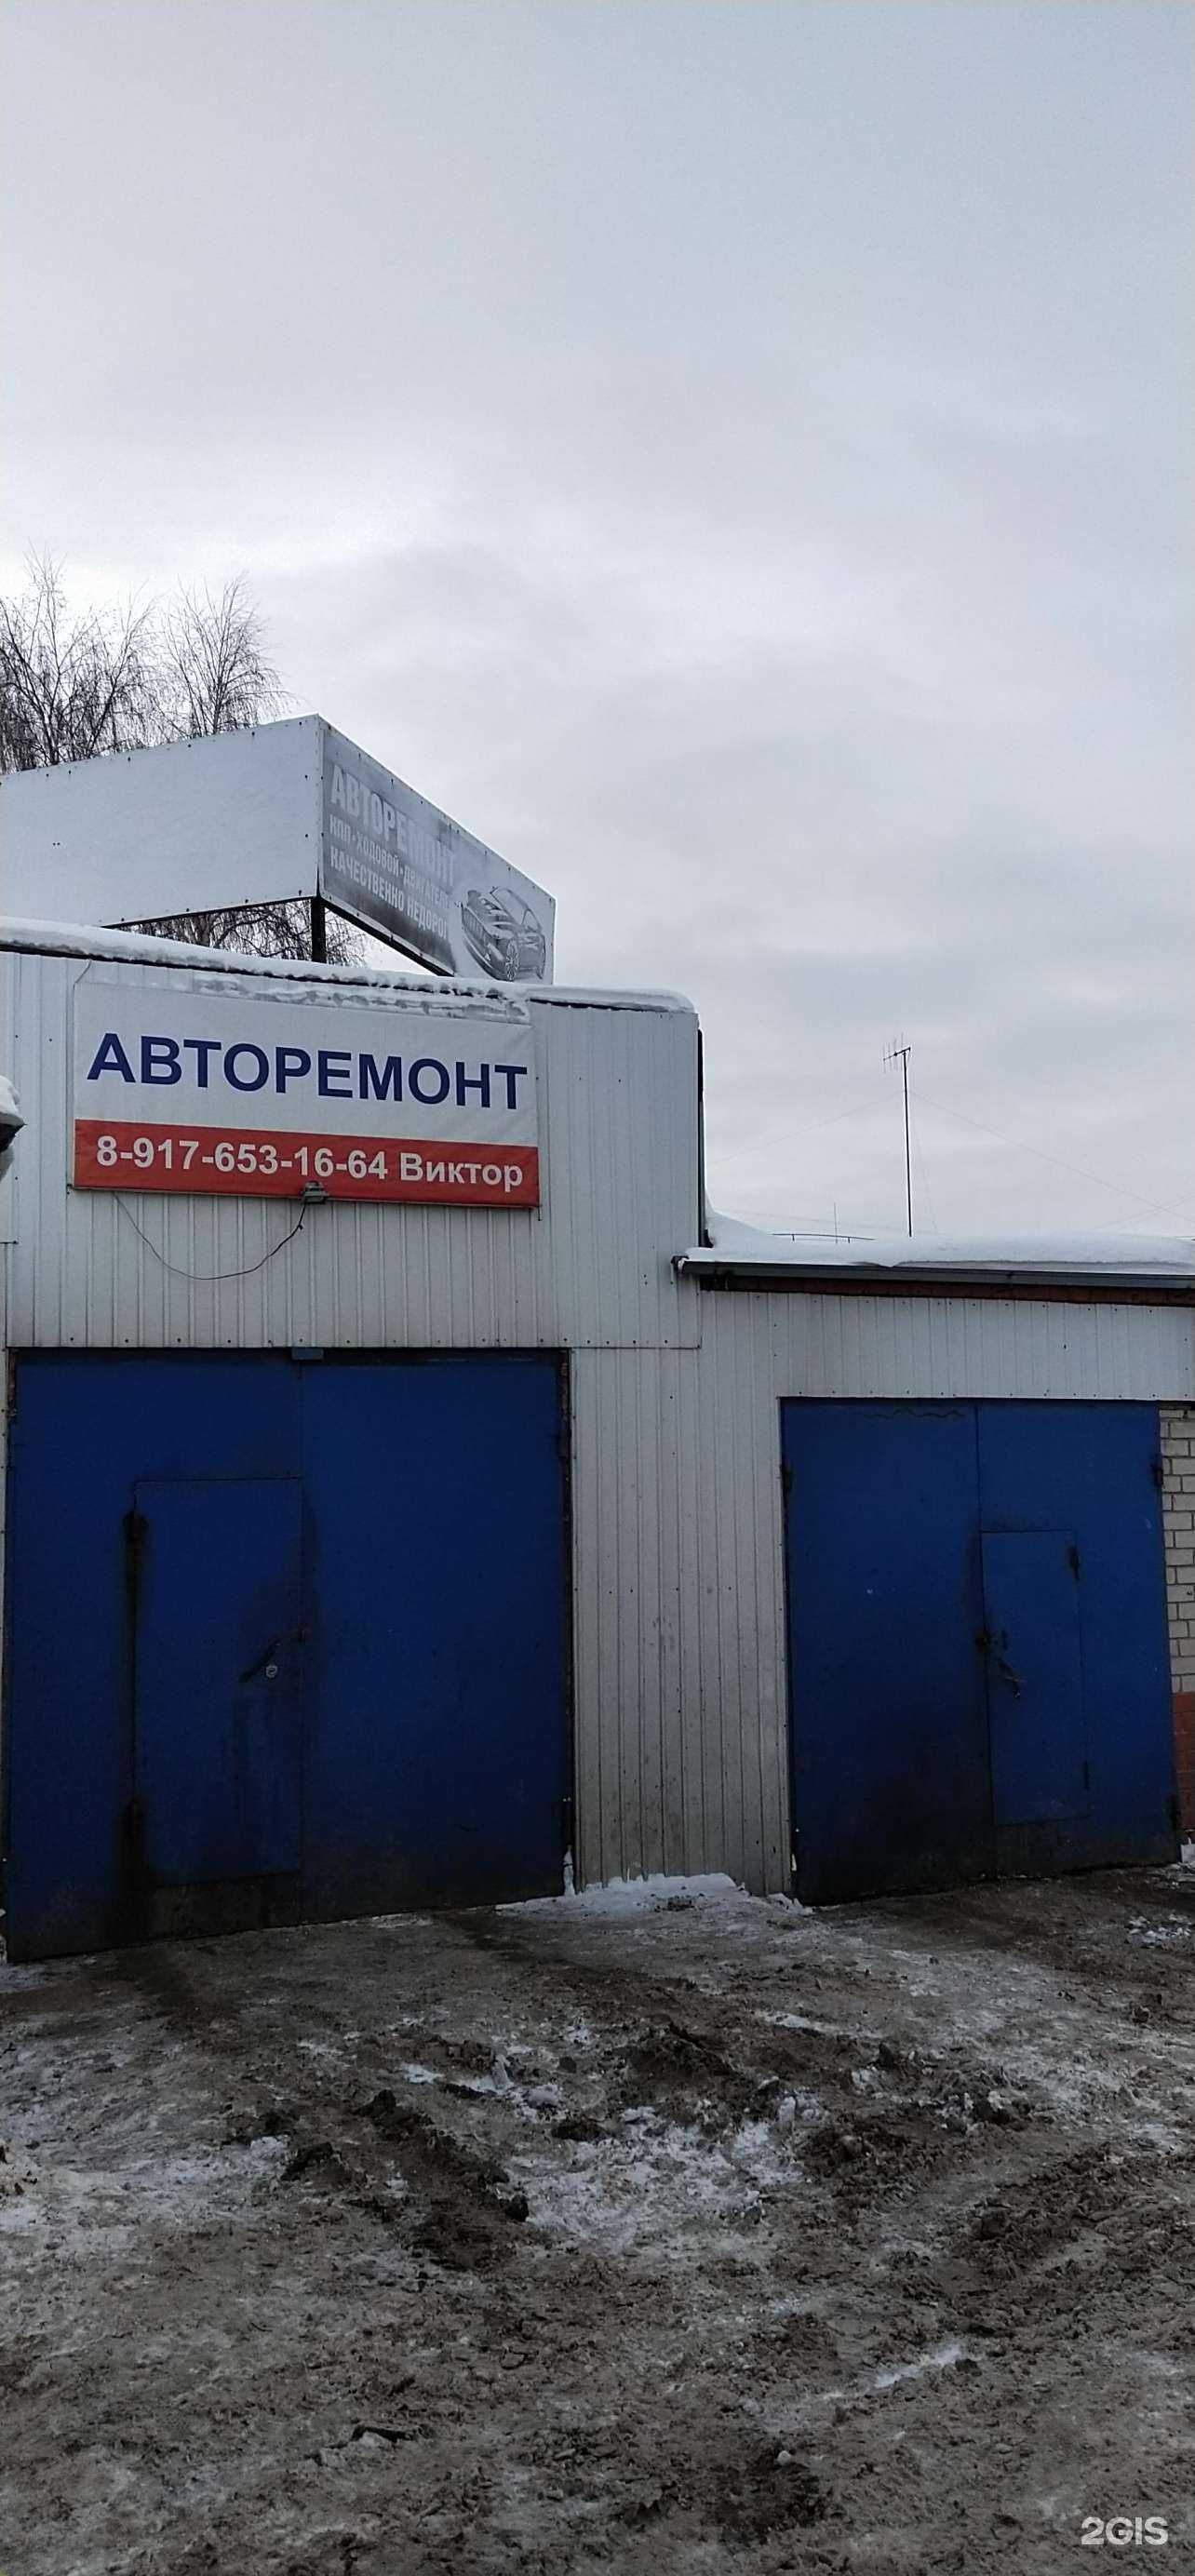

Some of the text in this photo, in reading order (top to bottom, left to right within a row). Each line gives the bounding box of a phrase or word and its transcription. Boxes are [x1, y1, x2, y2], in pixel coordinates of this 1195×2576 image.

[329, 813, 352, 845] КПП
[330, 764, 455, 887] АВТОРЕМОНТ
[329, 845, 405, 912] КАЧЕСТВЕННО
[87, 1032, 528, 1110] АВТОРЕМОНТ
[96, 1135, 524, 1193] 8-917-653-16-64 Виктор
